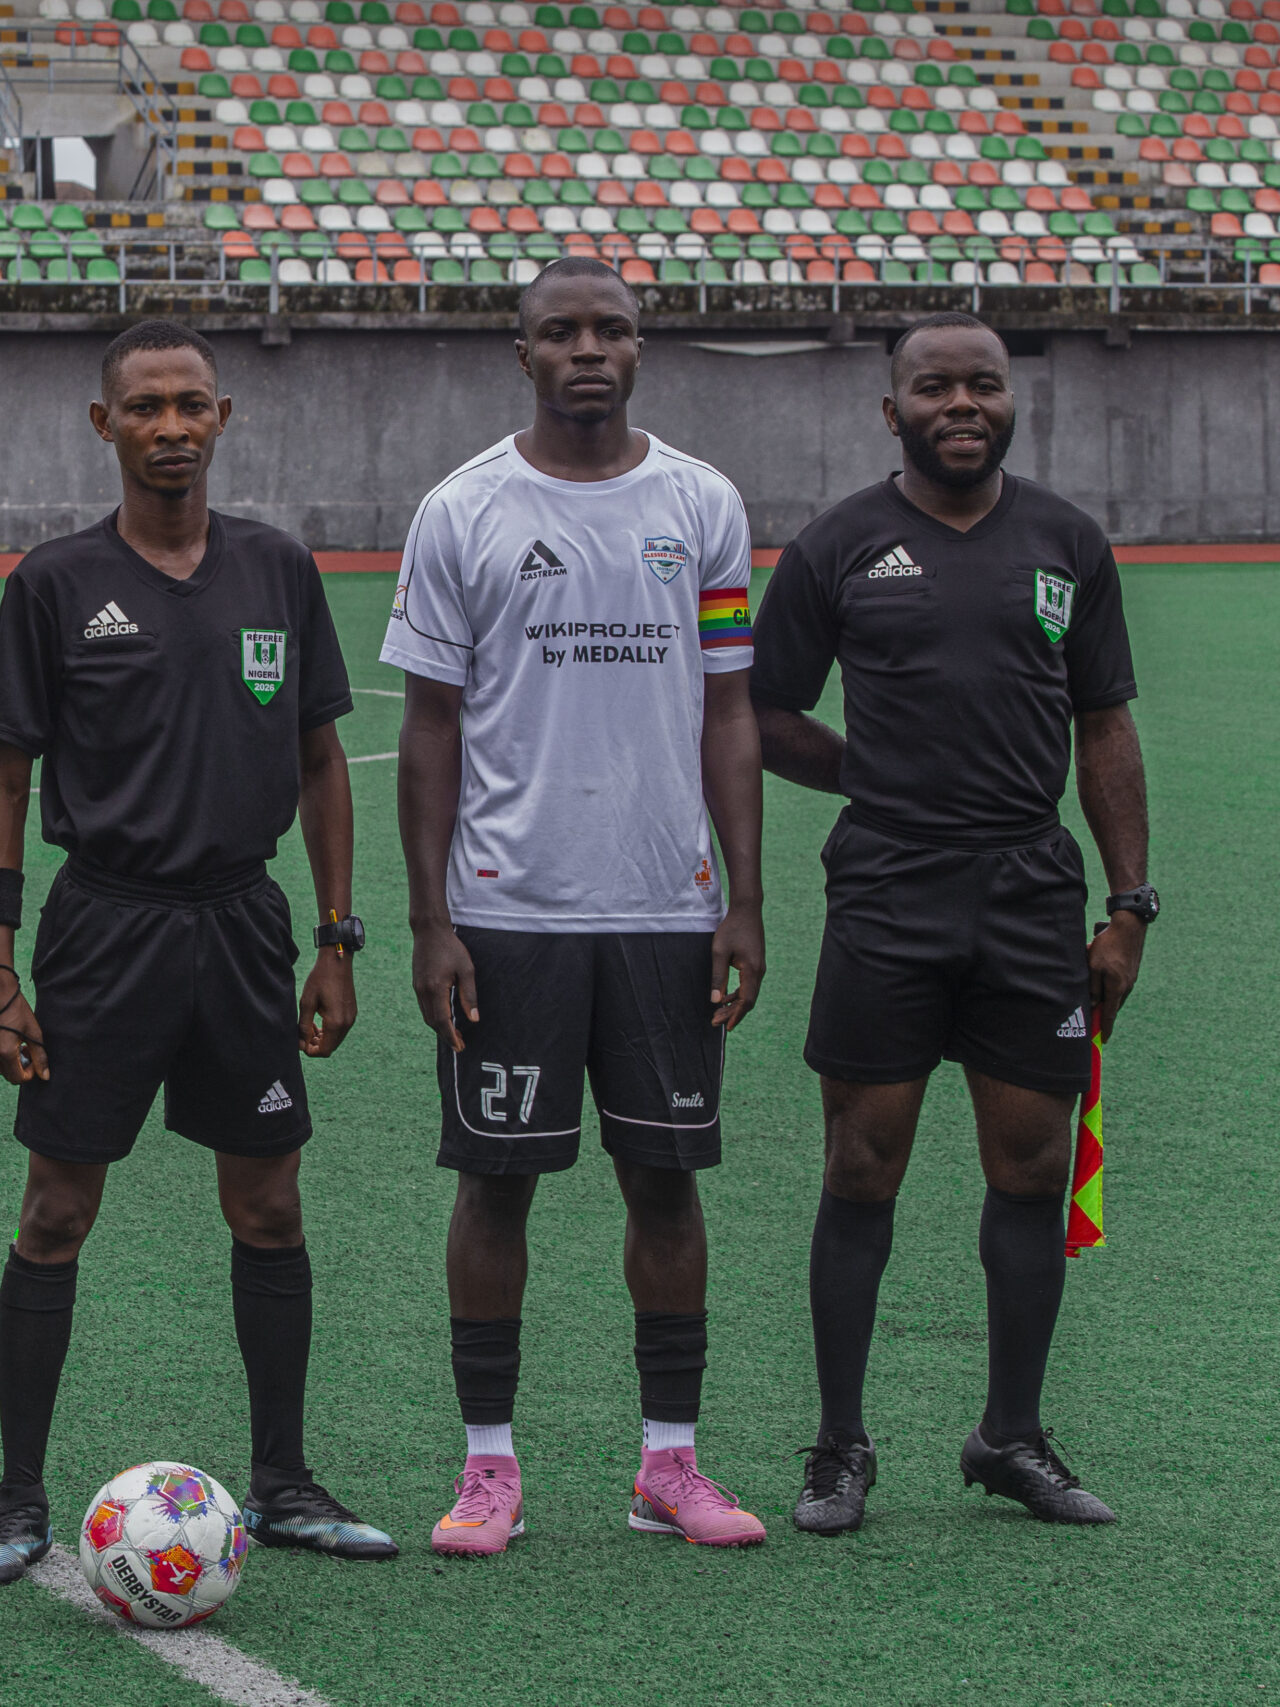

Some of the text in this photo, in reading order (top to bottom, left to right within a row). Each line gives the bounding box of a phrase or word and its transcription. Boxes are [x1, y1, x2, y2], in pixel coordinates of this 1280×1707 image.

[520, 568, 567, 581] KASTREAM
[868, 564, 923, 579] adidas
[1040, 575, 1072, 593] REFEREE
[1040, 607, 1065, 626] NIGERIA
[84, 622, 139, 639] adidas
[525, 622, 680, 640] WIKIPROJECT
[1044, 620, 1061, 634] 2026
[246, 633, 283, 643] REFEREE
[542, 645, 669, 668] by MEDALLY
[248, 670, 280, 680] NIGERIA
[254, 682, 275, 692] 2026
[1056, 1027, 1087, 1038] adidas
[481, 1061, 541, 1124] 27
[672, 1091, 704, 1108] Smile
[258, 1098, 293, 1113] adidas
[112, 1554, 182, 1622] DERBYSTAR
